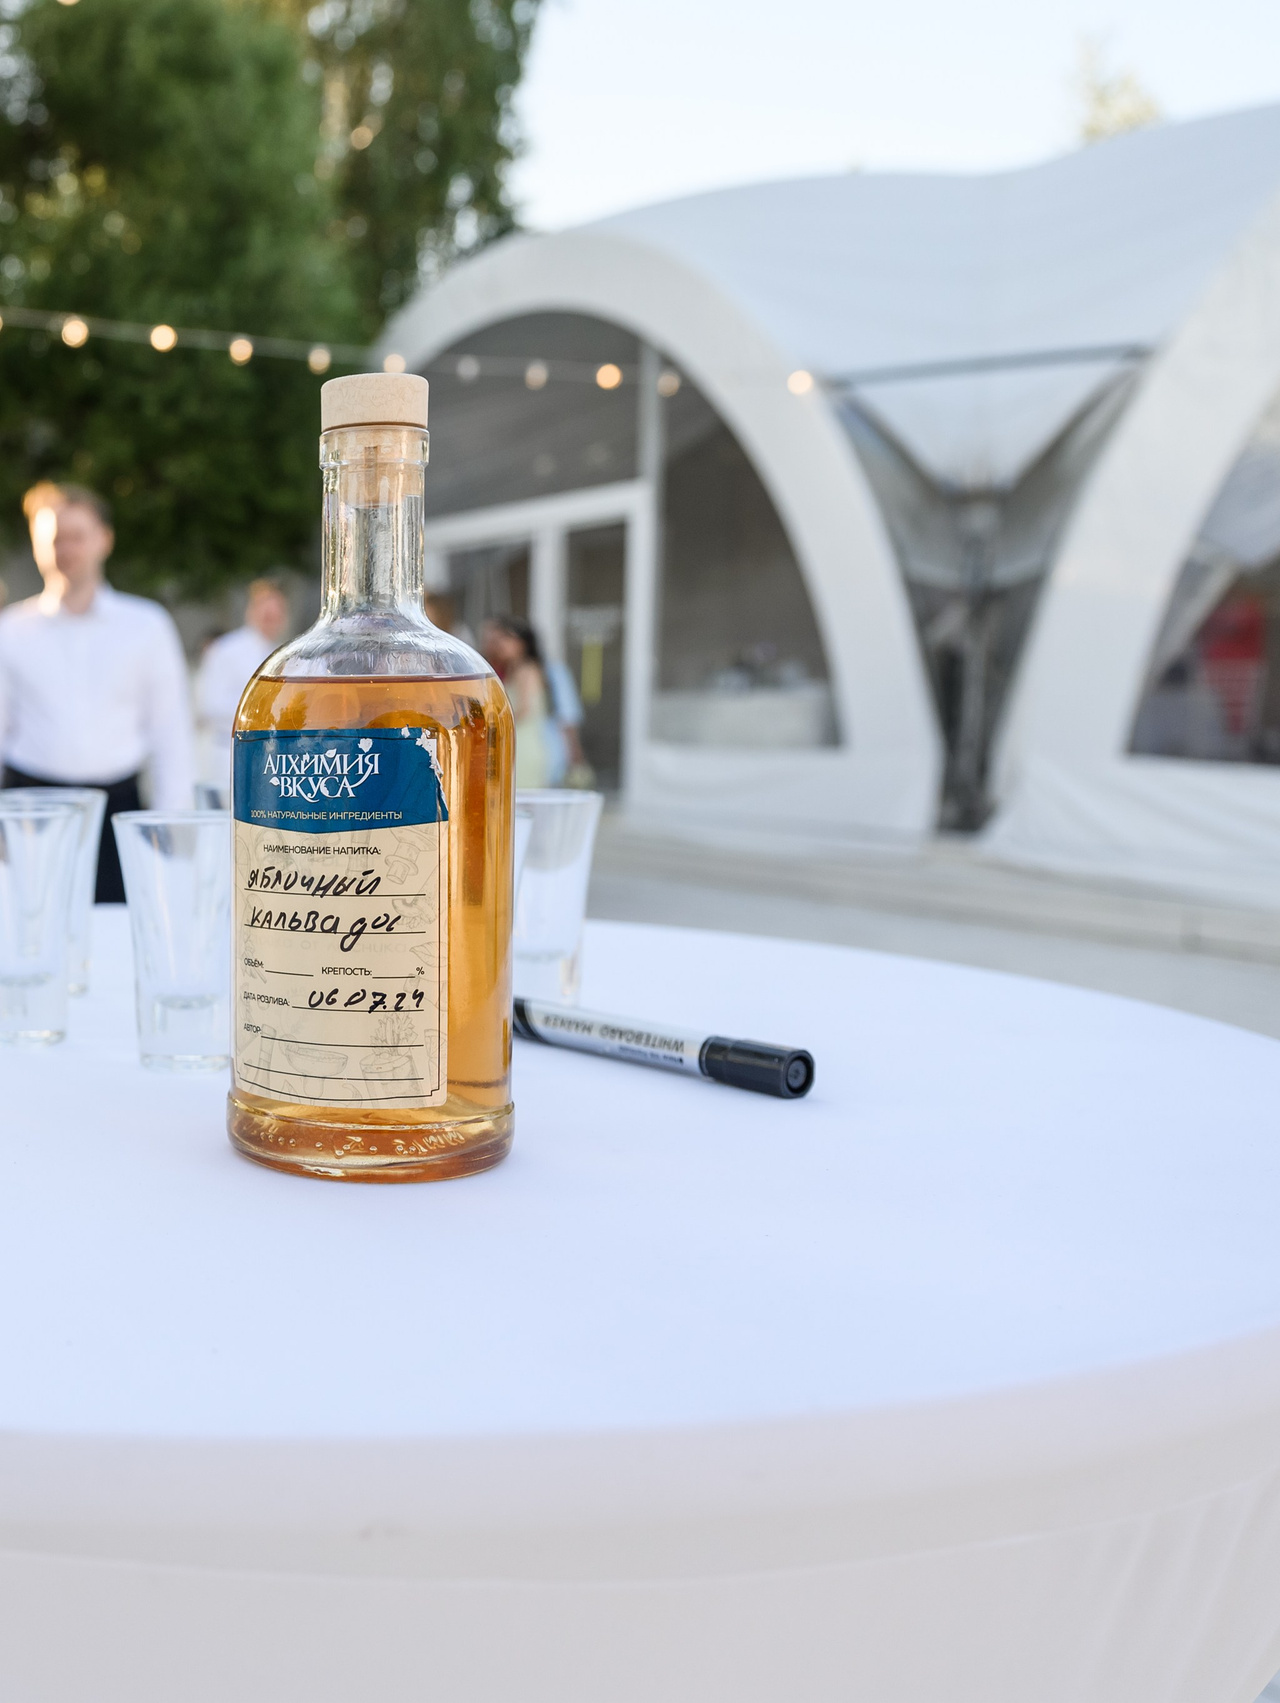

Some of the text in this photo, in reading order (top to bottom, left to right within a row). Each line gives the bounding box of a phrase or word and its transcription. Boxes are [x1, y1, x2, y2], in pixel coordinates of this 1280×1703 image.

[263, 749, 381, 779] АЛХИМИЯ
[278, 775, 357, 803] ВКУСА
[250, 809, 403, 821] 100% НАТУРАЛЬНЫЕ ИНГРЕДИЕНТЫ
[263, 844, 381, 856] НАИМЕНОВАНИЕ НАПИТКА:
[321, 966, 425, 977] КРЕПОСТЬ: %
[243, 991, 290, 1007] ДАТА РОЗЛИВА:
[243, 1023, 262, 1035] АВТОР:
[598, 1023, 685, 1053] WHITEBOARD
